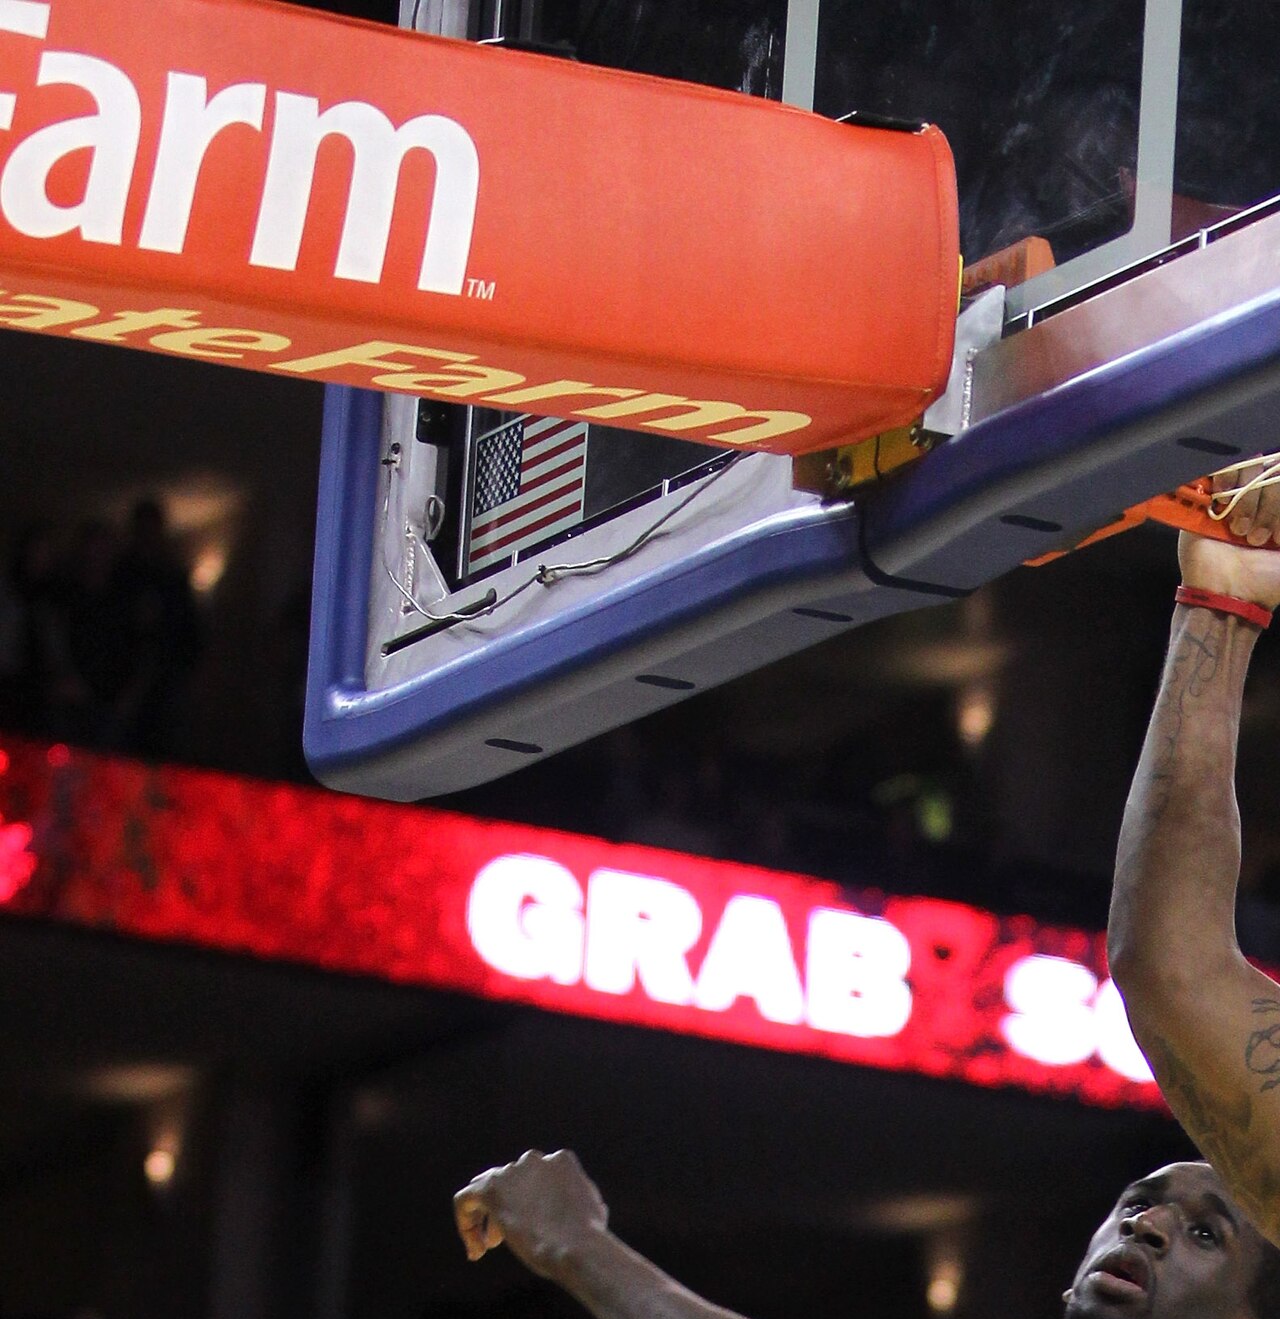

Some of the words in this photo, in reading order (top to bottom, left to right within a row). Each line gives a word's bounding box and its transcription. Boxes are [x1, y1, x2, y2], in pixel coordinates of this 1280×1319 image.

[0, 290, 292, 358] ate
[267, 340, 812, 444] Farm
[467, 852, 912, 1038] GRAB
